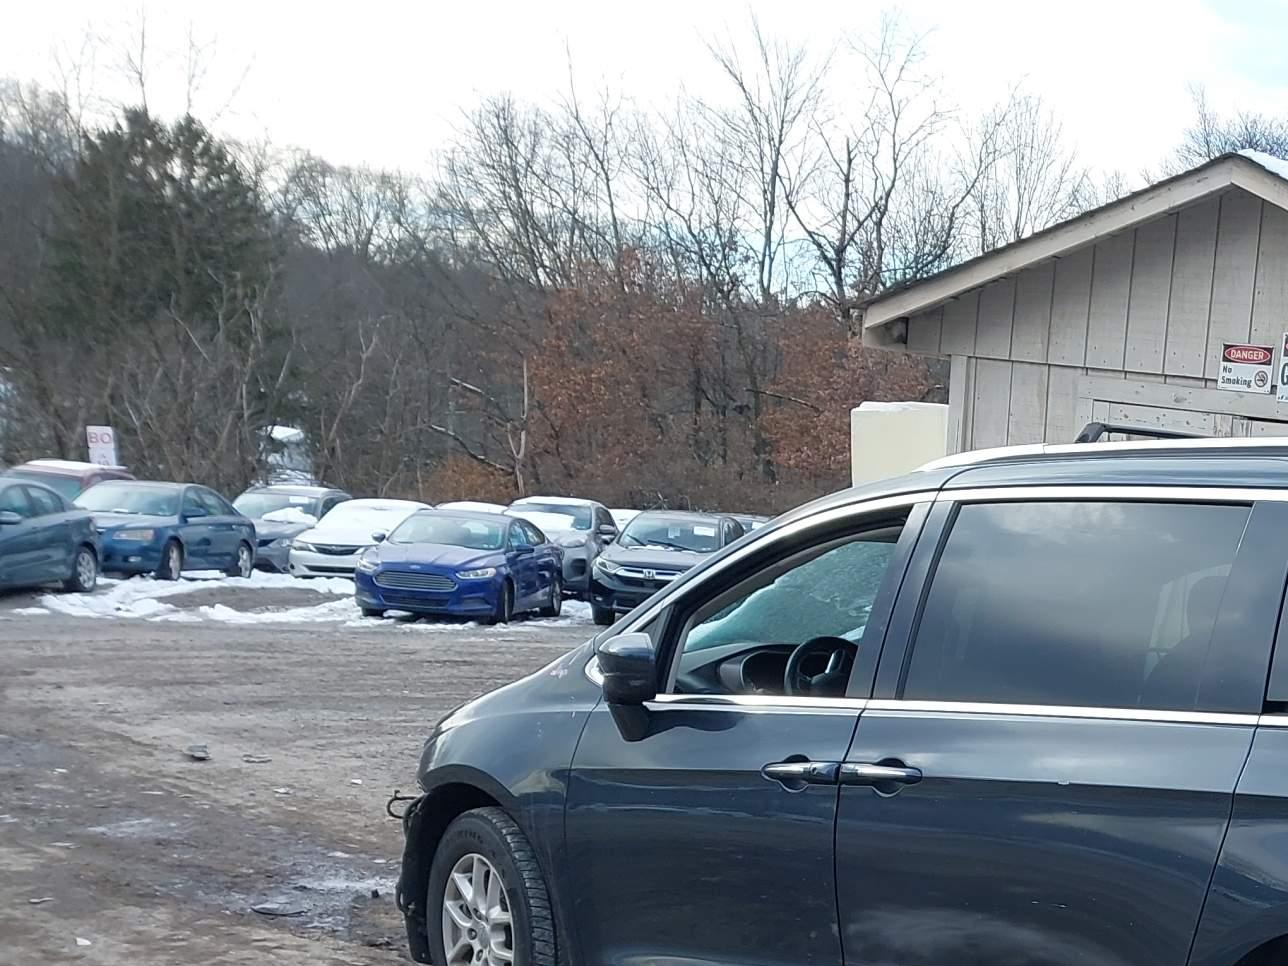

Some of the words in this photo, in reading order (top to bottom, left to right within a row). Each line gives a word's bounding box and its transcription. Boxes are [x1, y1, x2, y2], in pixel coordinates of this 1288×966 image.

[1230, 349, 1265, 360] DANGER
[1222, 365, 1232, 374] No
[1221, 376, 1252, 388] Smoking
